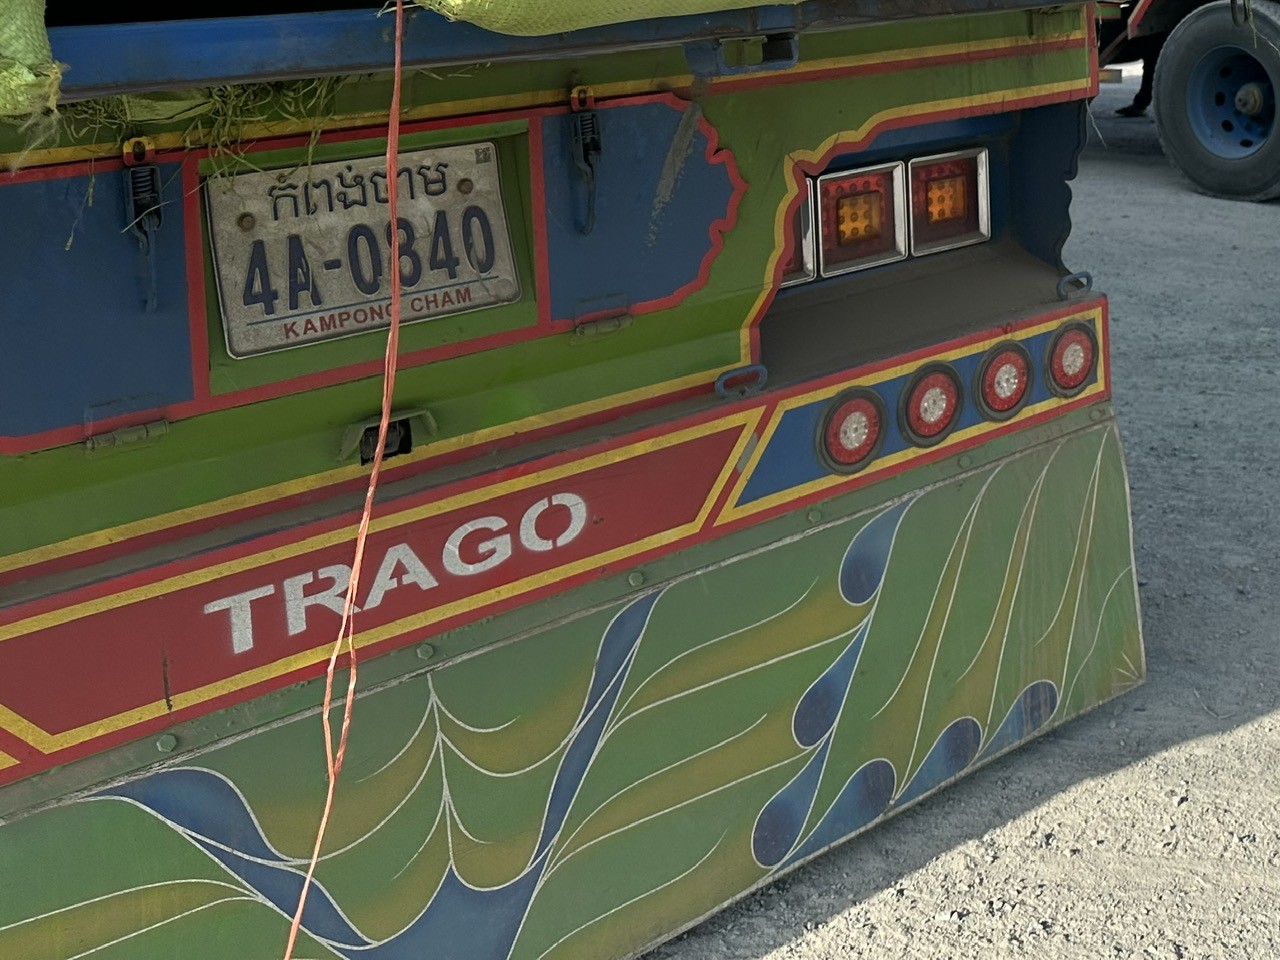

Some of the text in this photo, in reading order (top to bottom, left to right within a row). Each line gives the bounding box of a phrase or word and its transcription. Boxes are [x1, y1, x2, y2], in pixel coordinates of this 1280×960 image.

[243, 205, 495, 316] 4A-0840
[410, 286, 473, 314] CHAM
[204, 493, 587, 655] TRAGO
